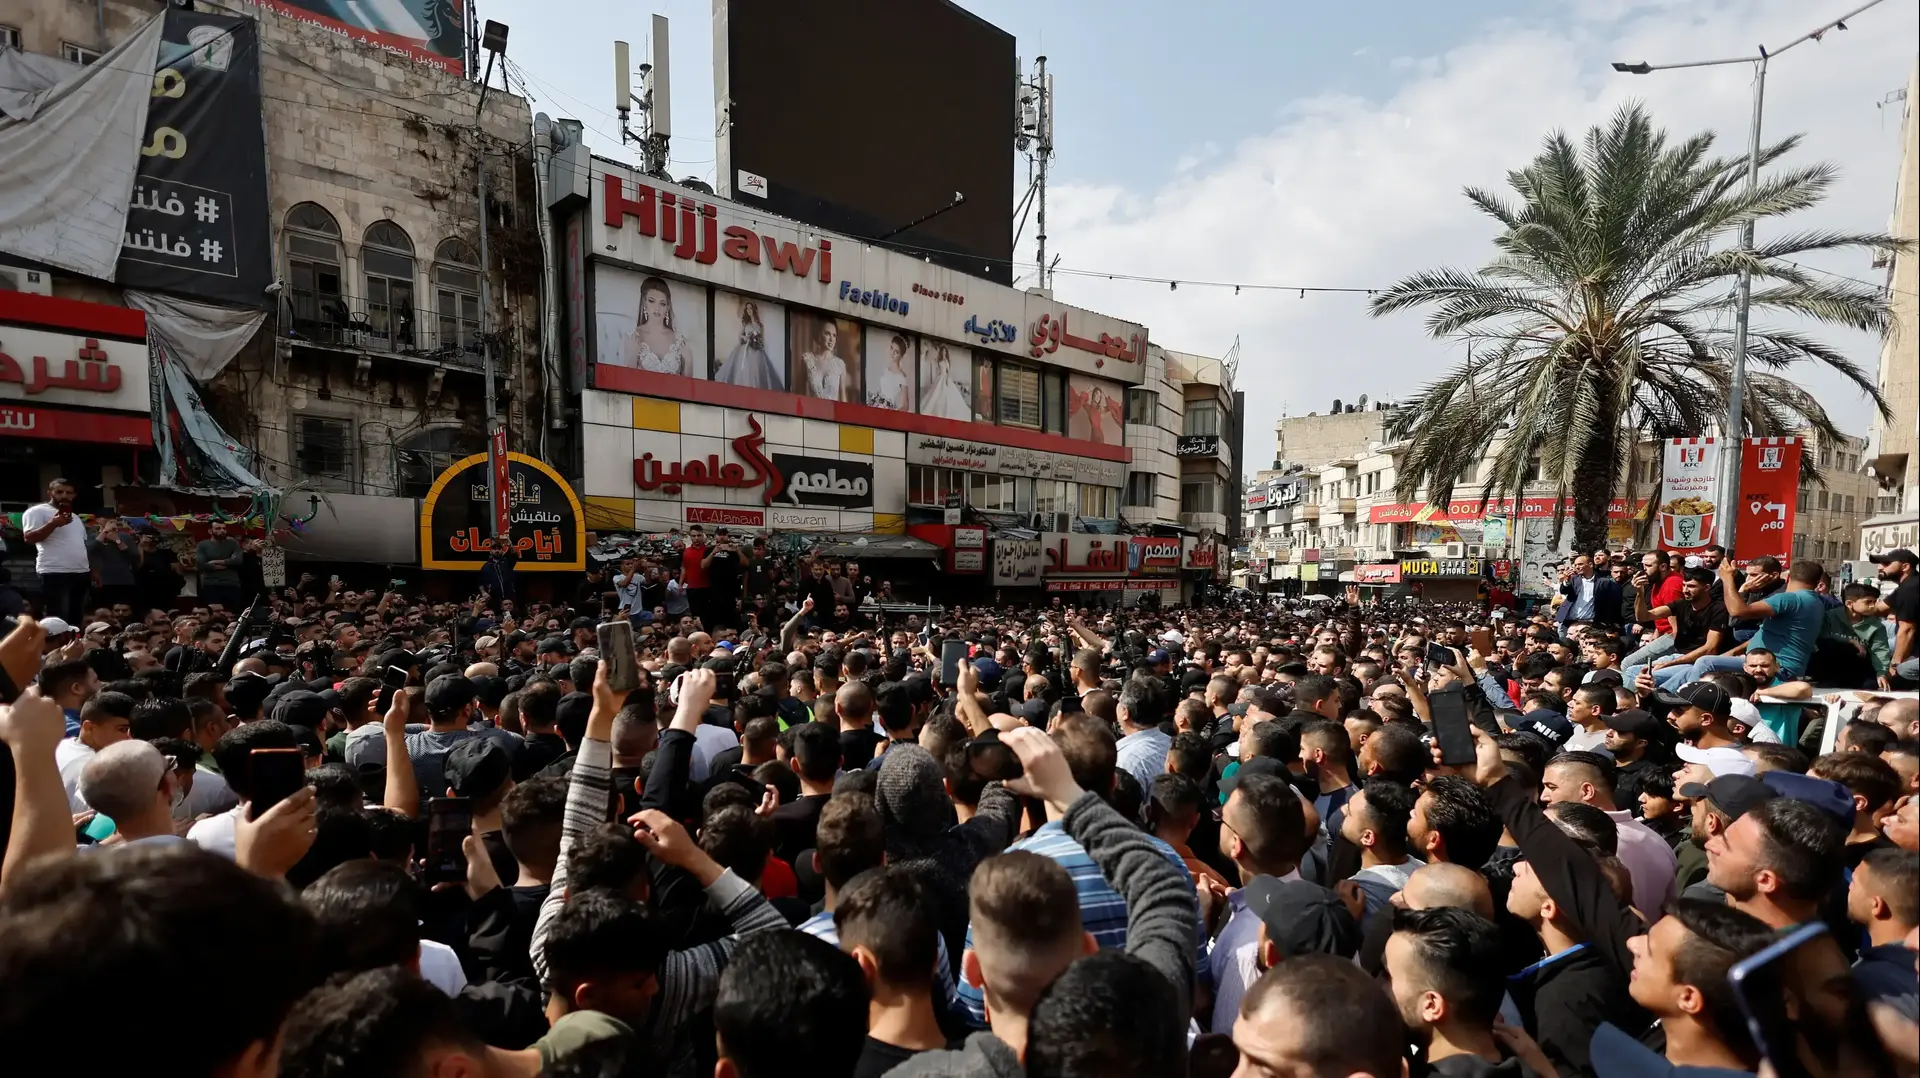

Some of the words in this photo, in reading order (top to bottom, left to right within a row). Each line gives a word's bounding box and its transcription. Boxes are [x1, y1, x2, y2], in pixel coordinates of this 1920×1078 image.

[604, 173, 832, 284] Hijjawi
[840, 280, 910, 317] Fashion
[912, 283, 940, 299] Since
[1029, 311, 1146, 368] الحجاوي
[786, 468, 869, 506] مطعم
[511, 508, 561, 524] مناقيش
[772, 512, 828, 526] Restaurant
[1448, 504, 1478, 515] OOJ
[450, 526, 509, 557] مان
[1143, 542, 1179, 564] مطعم
[1044, 537, 1128, 574] العقاد
[1402, 561, 1438, 574] MUCA
